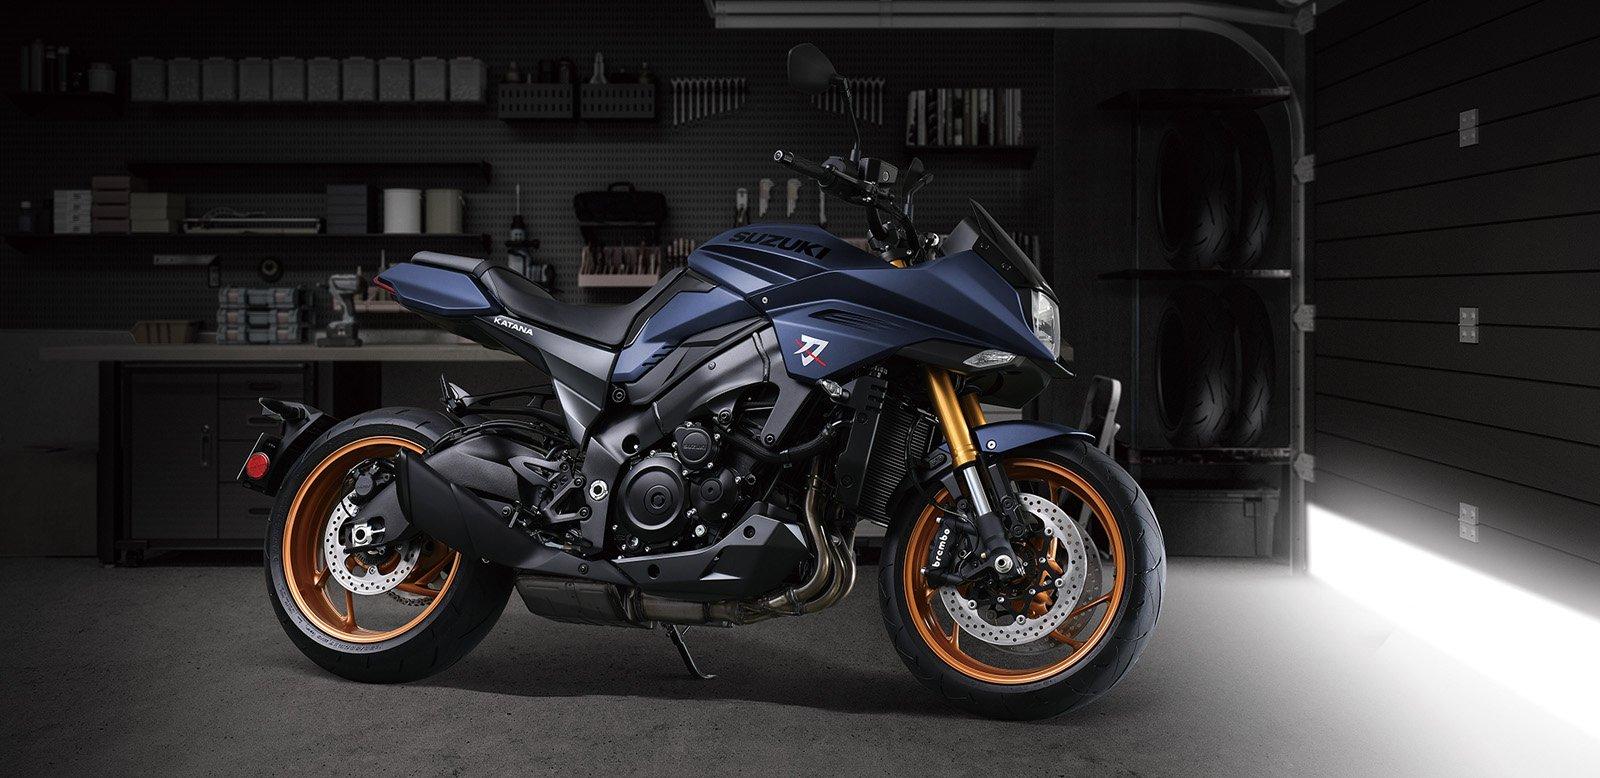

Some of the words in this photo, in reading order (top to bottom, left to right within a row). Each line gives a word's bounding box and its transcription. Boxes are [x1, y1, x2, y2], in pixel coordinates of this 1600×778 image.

[729, 232, 832, 260] SUZUKI
[493, 317, 534, 336] KATANA
[931, 528, 950, 567] brembo
